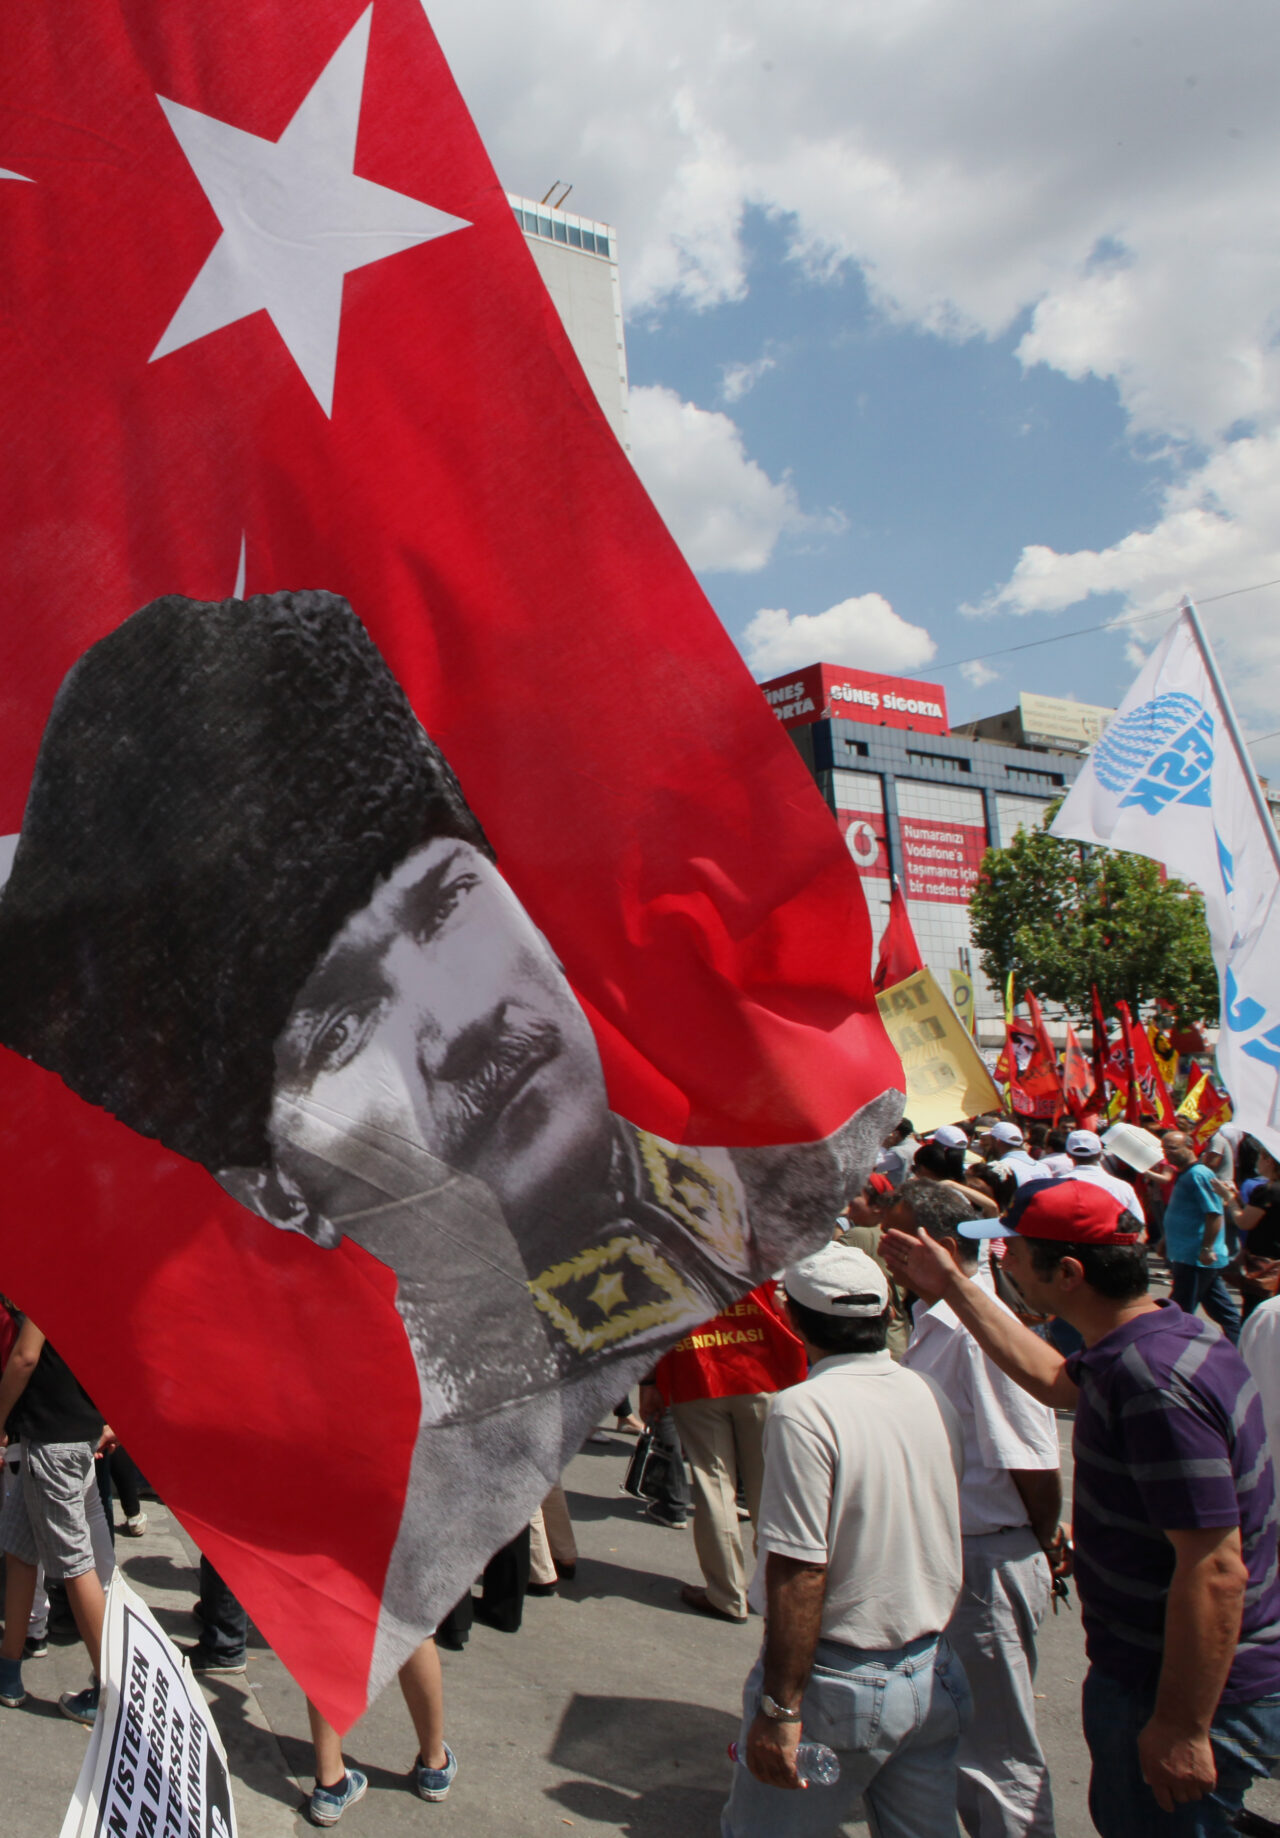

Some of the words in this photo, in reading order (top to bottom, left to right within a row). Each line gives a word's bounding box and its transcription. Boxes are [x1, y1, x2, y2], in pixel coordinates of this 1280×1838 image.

[763, 682, 805, 705] ÜNEŞ
[830, 684, 880, 710] GÜNEŞ
[882, 692, 943, 718] SİGORTA
[773, 698, 816, 720] ORTA
[904, 824, 964, 844] Numaranızı
[905, 842, 963, 862] Vodafone'a
[907, 862, 959, 879] taşımanız
[960, 866, 979, 883] için
[909, 880, 924, 894] bir
[925, 883, 958, 897] neden
[675, 1328, 765, 1352] SENDİKASI
[112, 1646, 150, 1811] İSTERSEN
[143, 1667, 170, 1806] DEĞİŞİR
[162, 1707, 185, 1838] STERSEN
[187, 1711, 203, 1838] AKINDIR
